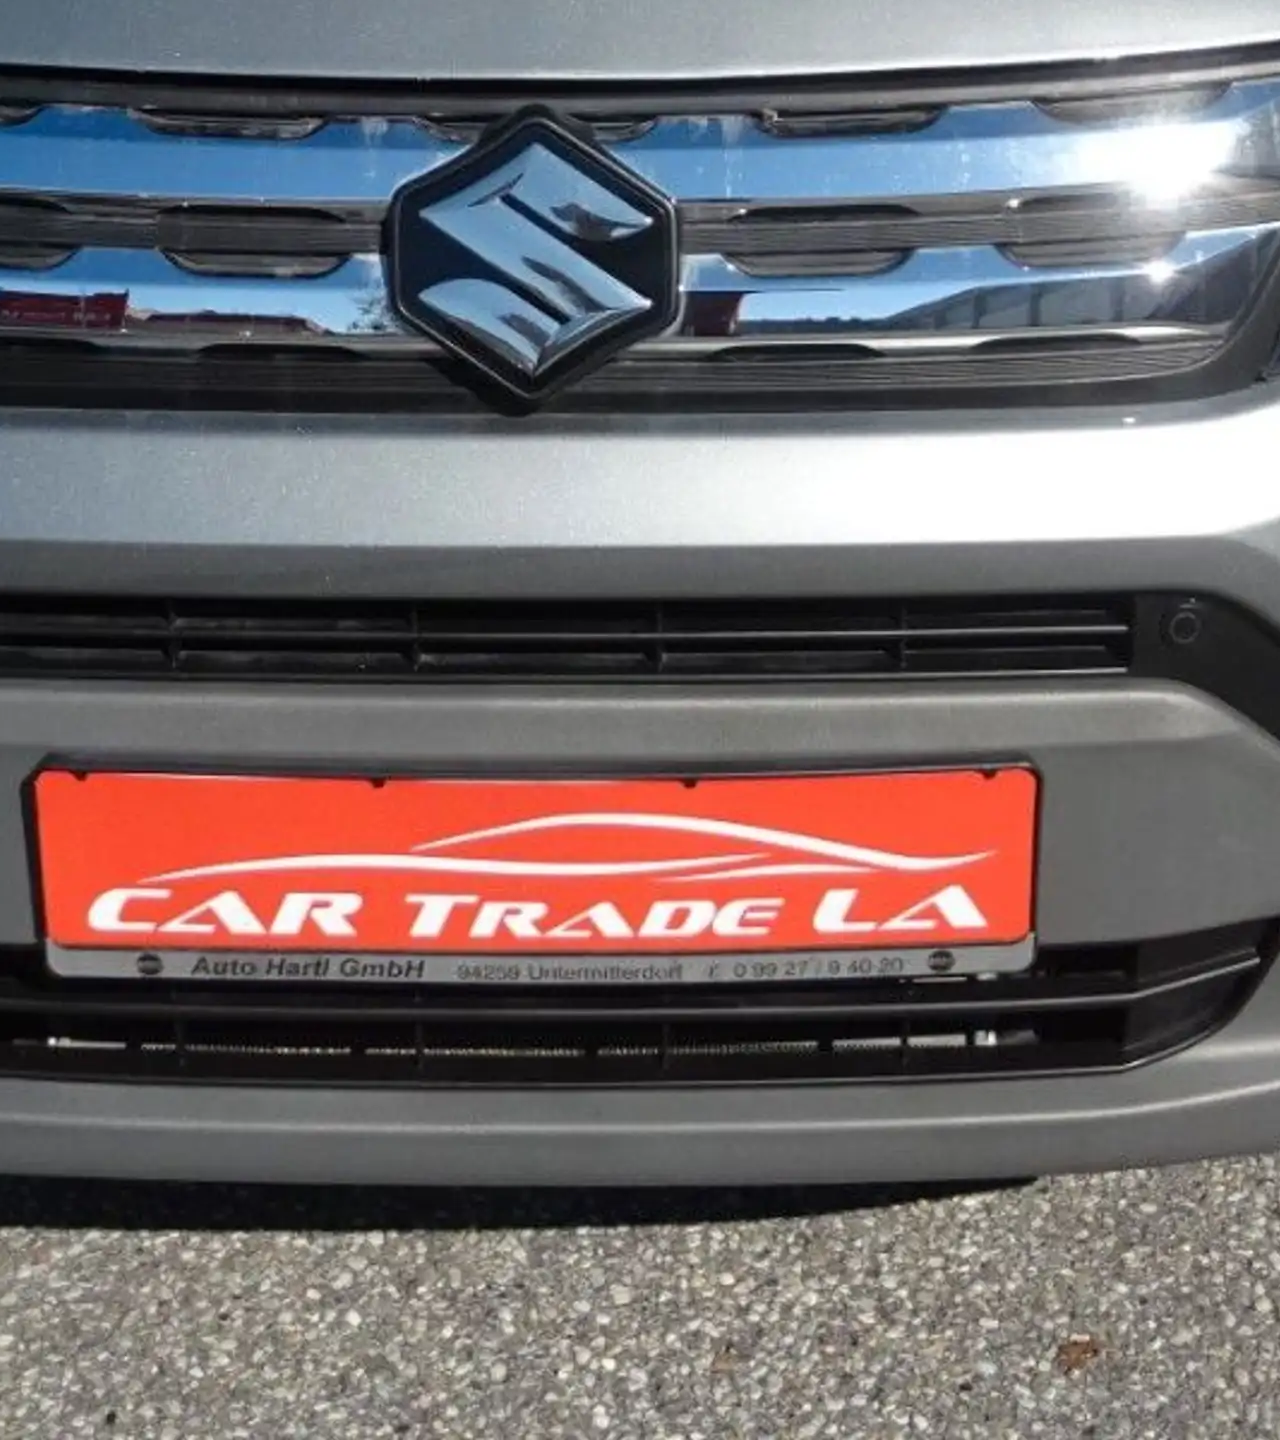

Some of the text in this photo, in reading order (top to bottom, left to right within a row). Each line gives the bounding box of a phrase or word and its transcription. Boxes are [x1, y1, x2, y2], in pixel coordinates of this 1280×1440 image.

[87, 883, 989, 939] CAR TRADE LA
[190, 956, 258, 978] Auto
[265, 957, 331, 979] Hartl
[338, 957, 425, 980] GmbH
